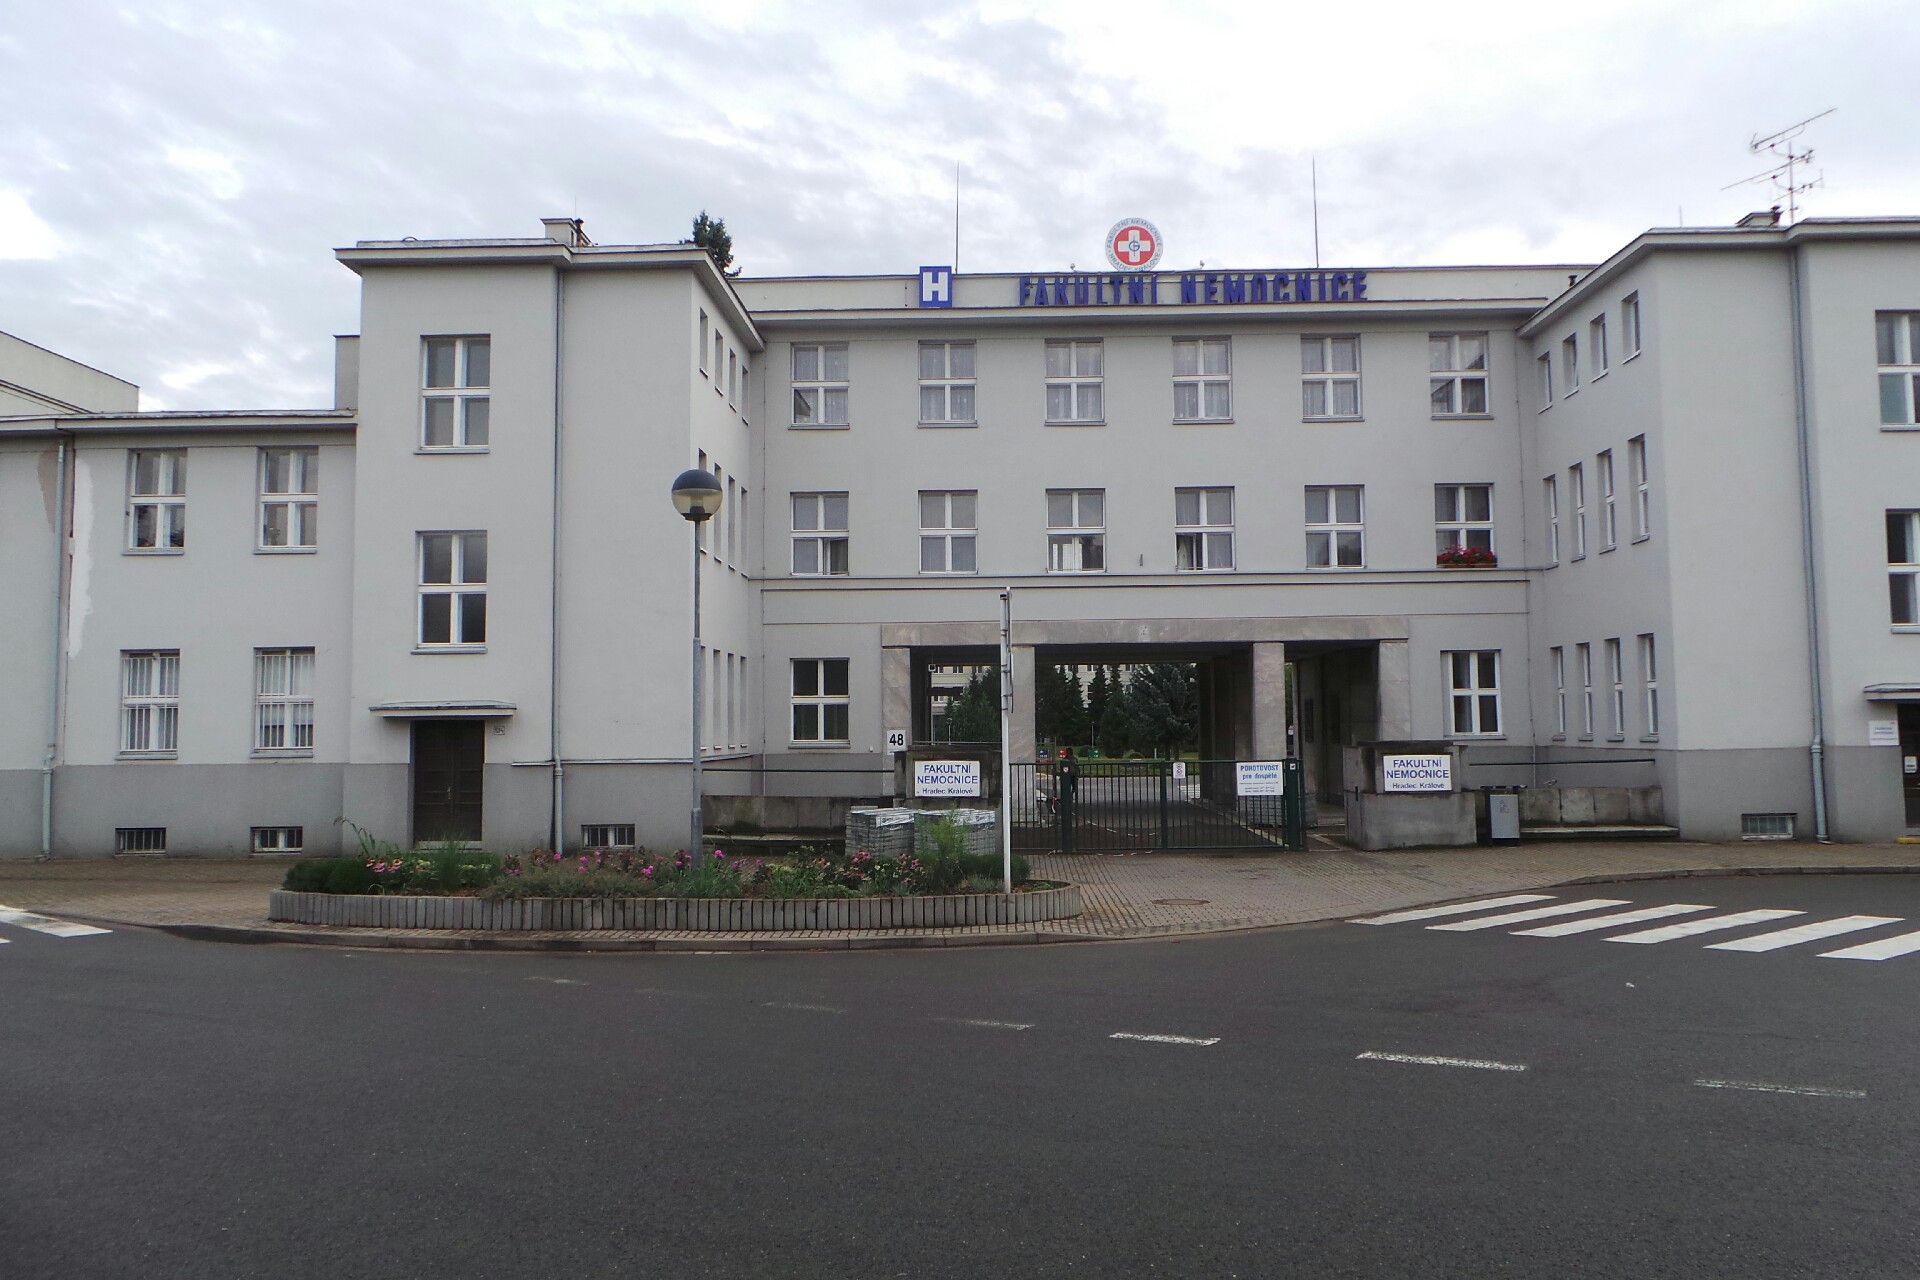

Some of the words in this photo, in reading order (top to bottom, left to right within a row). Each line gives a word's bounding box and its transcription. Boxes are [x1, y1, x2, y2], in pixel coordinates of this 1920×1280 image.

[922, 271, 949, 302] H
[1180, 270, 1368, 304] NEMOCNICE
[889, 733, 904, 746] 48
[1393, 757, 1442, 768] FAKULTNÍ
[924, 763, 971, 774] FAKULTNÍ
[1386, 769, 1450, 779] NEMOCNICE
[917, 775, 979, 785] NEMOCNICE
